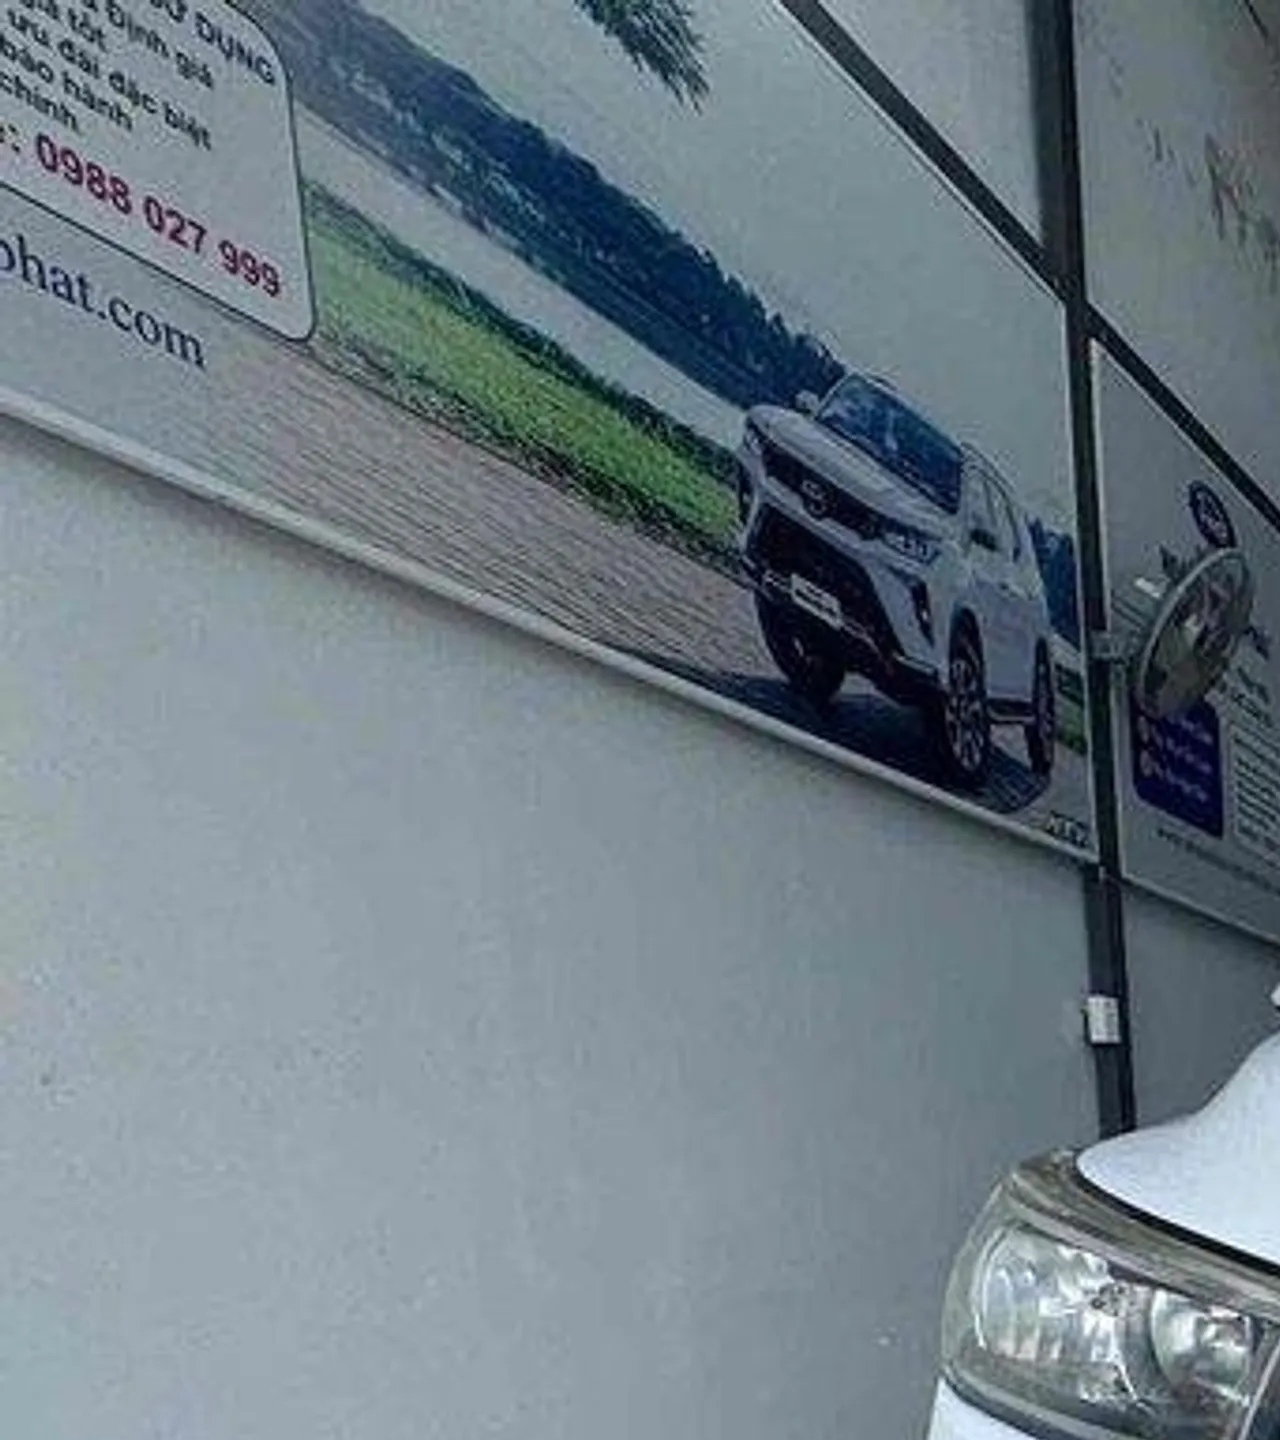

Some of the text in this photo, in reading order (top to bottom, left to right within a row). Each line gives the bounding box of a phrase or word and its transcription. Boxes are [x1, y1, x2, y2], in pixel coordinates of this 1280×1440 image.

[194, 11, 276, 85] DỤNG
[36, 132, 132, 215] 0988
[142, 194, 208, 255] 027
[217, 239, 281, 298] 999
